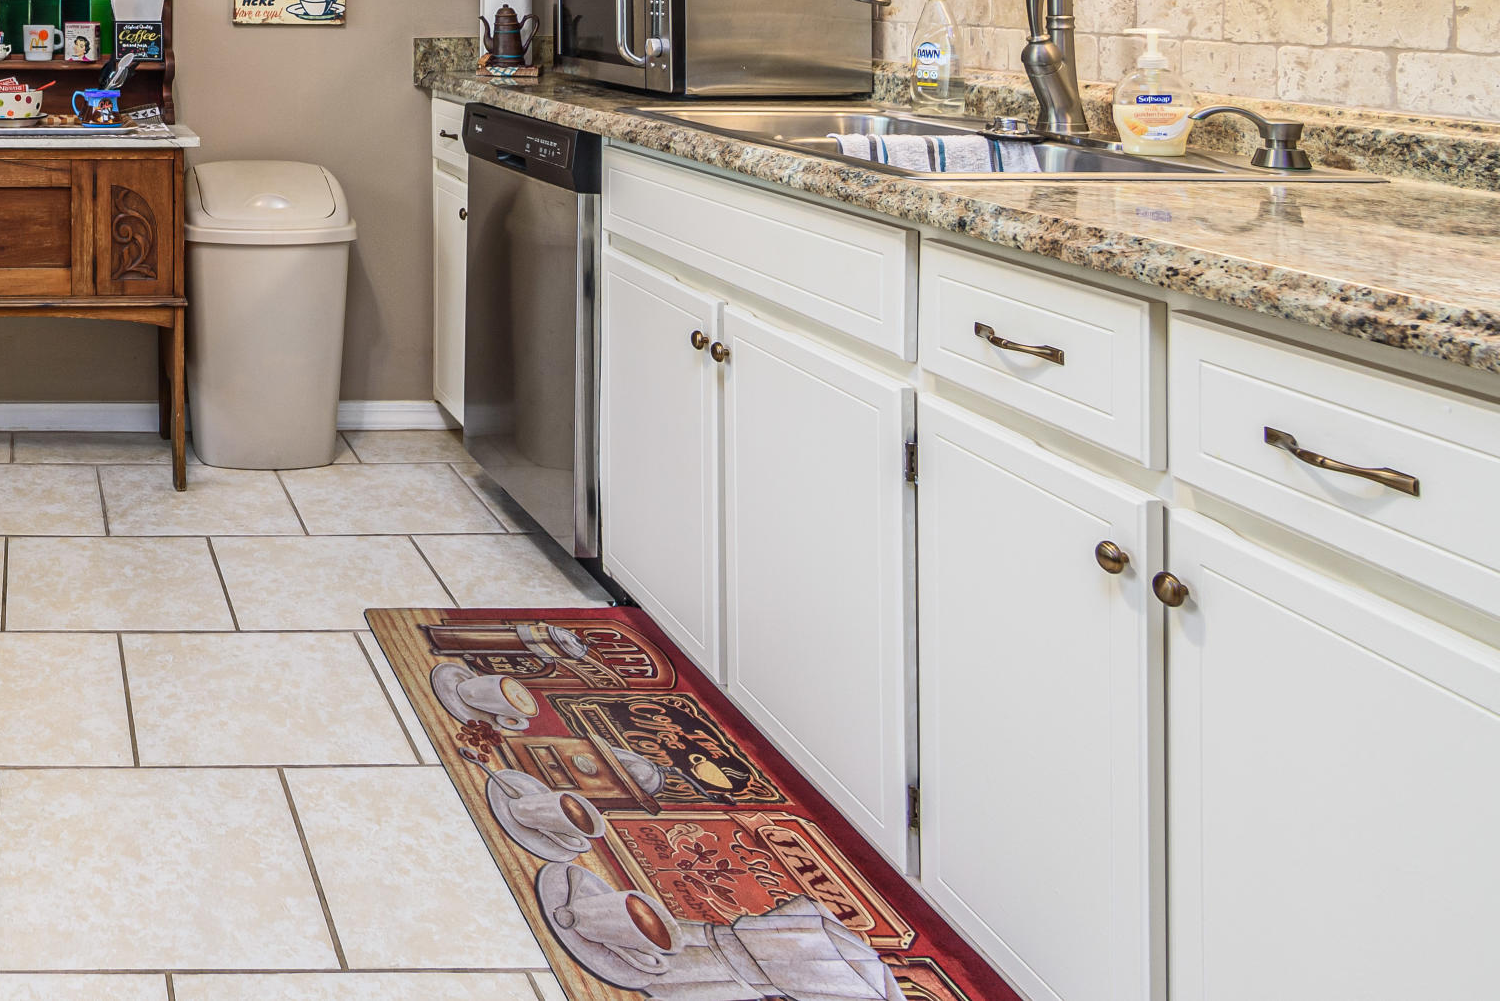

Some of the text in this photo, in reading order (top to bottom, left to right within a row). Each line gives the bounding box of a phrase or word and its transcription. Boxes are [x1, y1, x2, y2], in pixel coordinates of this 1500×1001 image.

[118, 29, 161, 43] Coffee
[916, 48, 940, 59] DAWN
[1138, 95, 1170, 103] Softsoap
[583, 628, 653, 678] CAFE
[628, 702, 687, 749] Coffee
[693, 729, 730, 759] THE
[622, 730, 698, 795] Compny
[618, 828, 688, 920] MOCHA JAV
[767, 832, 861, 921] JAVA
